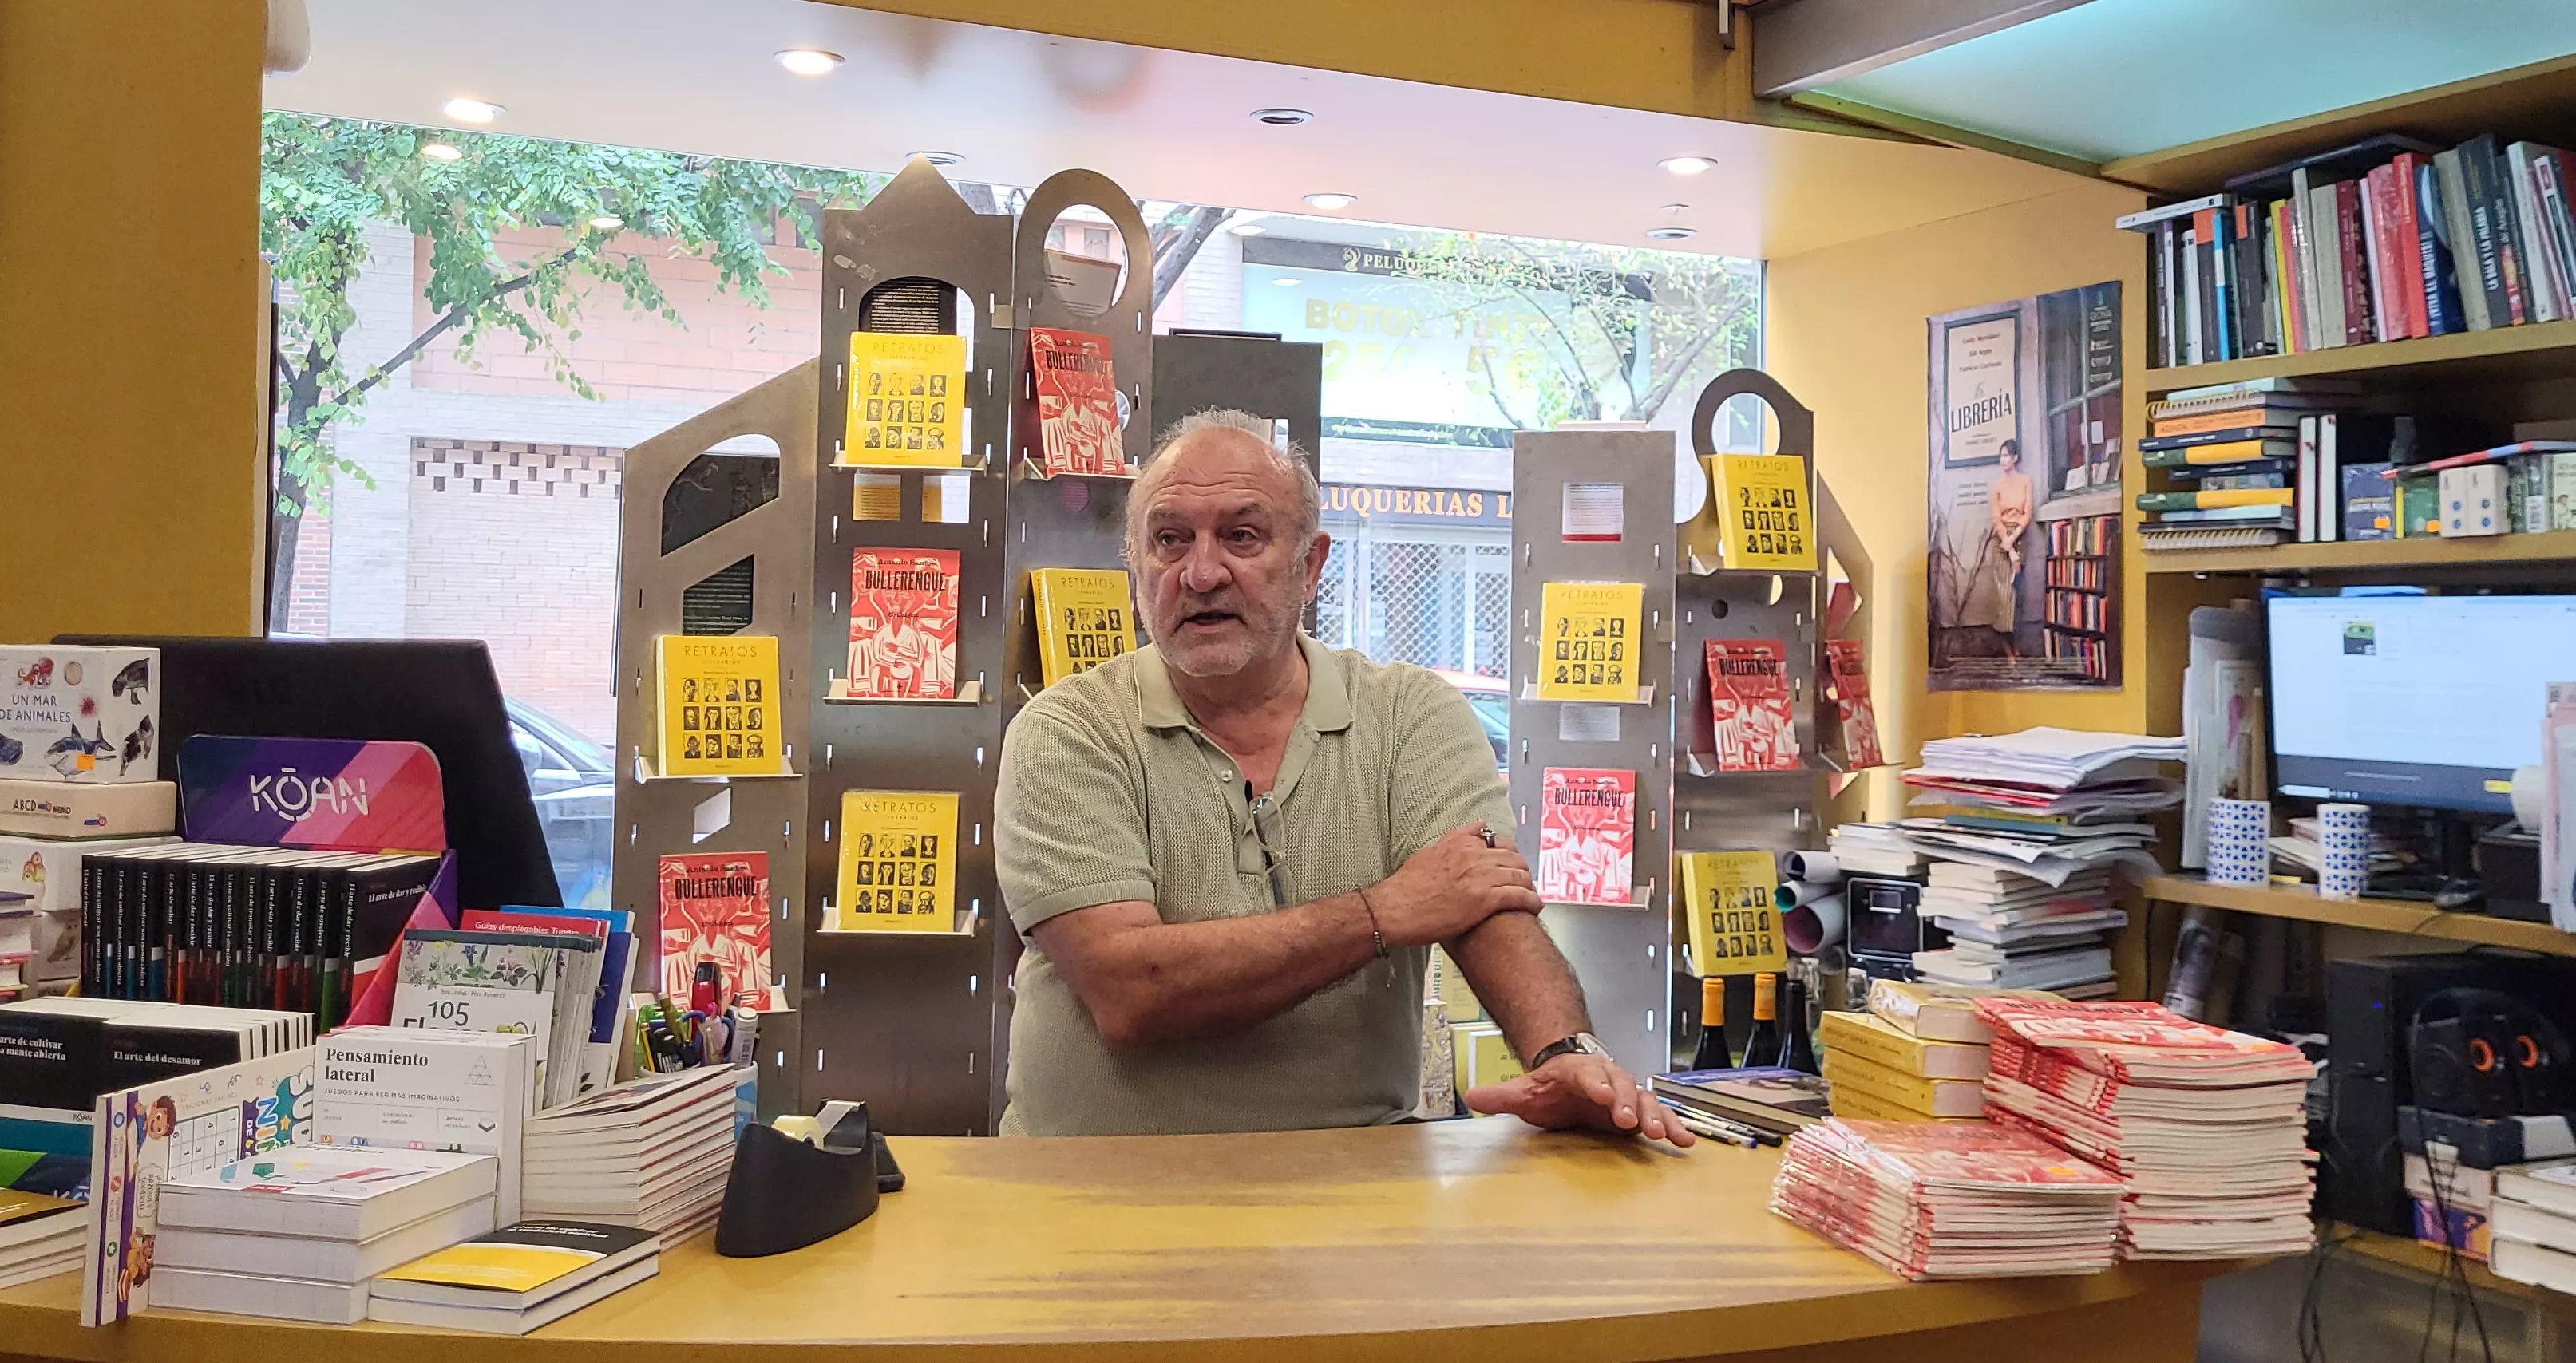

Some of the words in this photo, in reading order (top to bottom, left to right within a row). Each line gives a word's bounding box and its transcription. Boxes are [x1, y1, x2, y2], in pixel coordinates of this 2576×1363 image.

[873, 342, 945, 353] RETRATOS
[1951, 388, 2012, 433] LIBRERÍA
[865, 570, 946, 591] BULLERENGUE
[1062, 577, 1114, 588] RETRATOS
[1561, 590, 1623, 599] RETRATOS
[684, 646, 757, 658] RETRATOS
[12, 695, 29, 705] UN
[34, 695, 57, 707] MAR
[15, 710, 71, 723] ANIMALES
[1555, 788, 1624, 808] BULLERENGUE
[13, 799, 37, 812] ABCD
[864, 801, 936, 814] RETRATOS
[675, 876, 758, 899] BULLERENGUE
[475, 922, 497, 930] Guías
[498, 923, 549, 934] desplegables
[428, 1000, 469, 1026] 105
[18, 1037, 28, 1047] de
[29, 1038, 63, 1049] cultivar
[6, 1049, 33, 1057] mente
[34, 1049, 66, 1061] abierta
[113, 1051, 123, 1061] El
[125, 1053, 144, 1062] arte
[145, 1053, 160, 1063] del
[160, 1055, 202, 1066] desamor
[326, 1048, 429, 1066] Pensamiento
[325, 1066, 375, 1083] lateral
[408, 1094, 460, 1103] IMAGINATIVOS
[247, 1119, 253, 1136] DE
